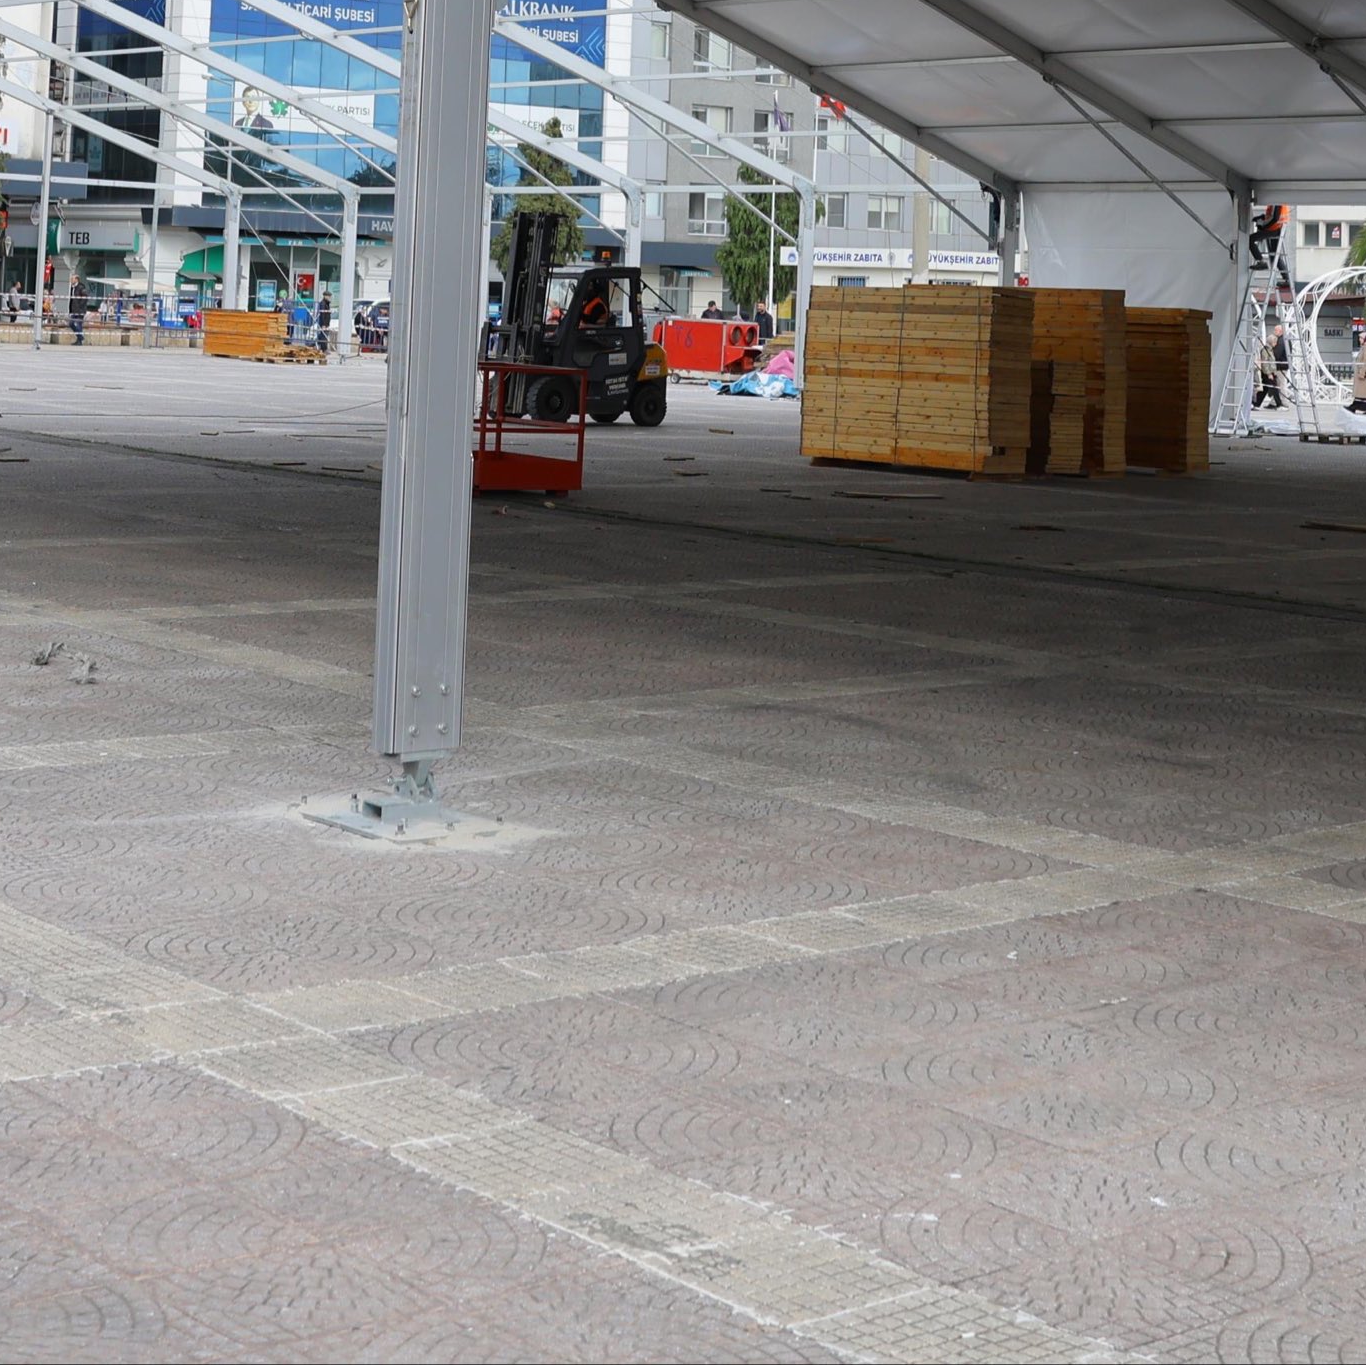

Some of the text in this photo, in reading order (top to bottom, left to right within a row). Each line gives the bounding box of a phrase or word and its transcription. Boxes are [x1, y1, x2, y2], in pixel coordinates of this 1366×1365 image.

[335, 7, 374, 23] ŞUBESİ
[496, 0, 575, 22] ALKBANK
[69, 232, 90, 245] TEB
[854, 253, 882, 262] ZABITA
